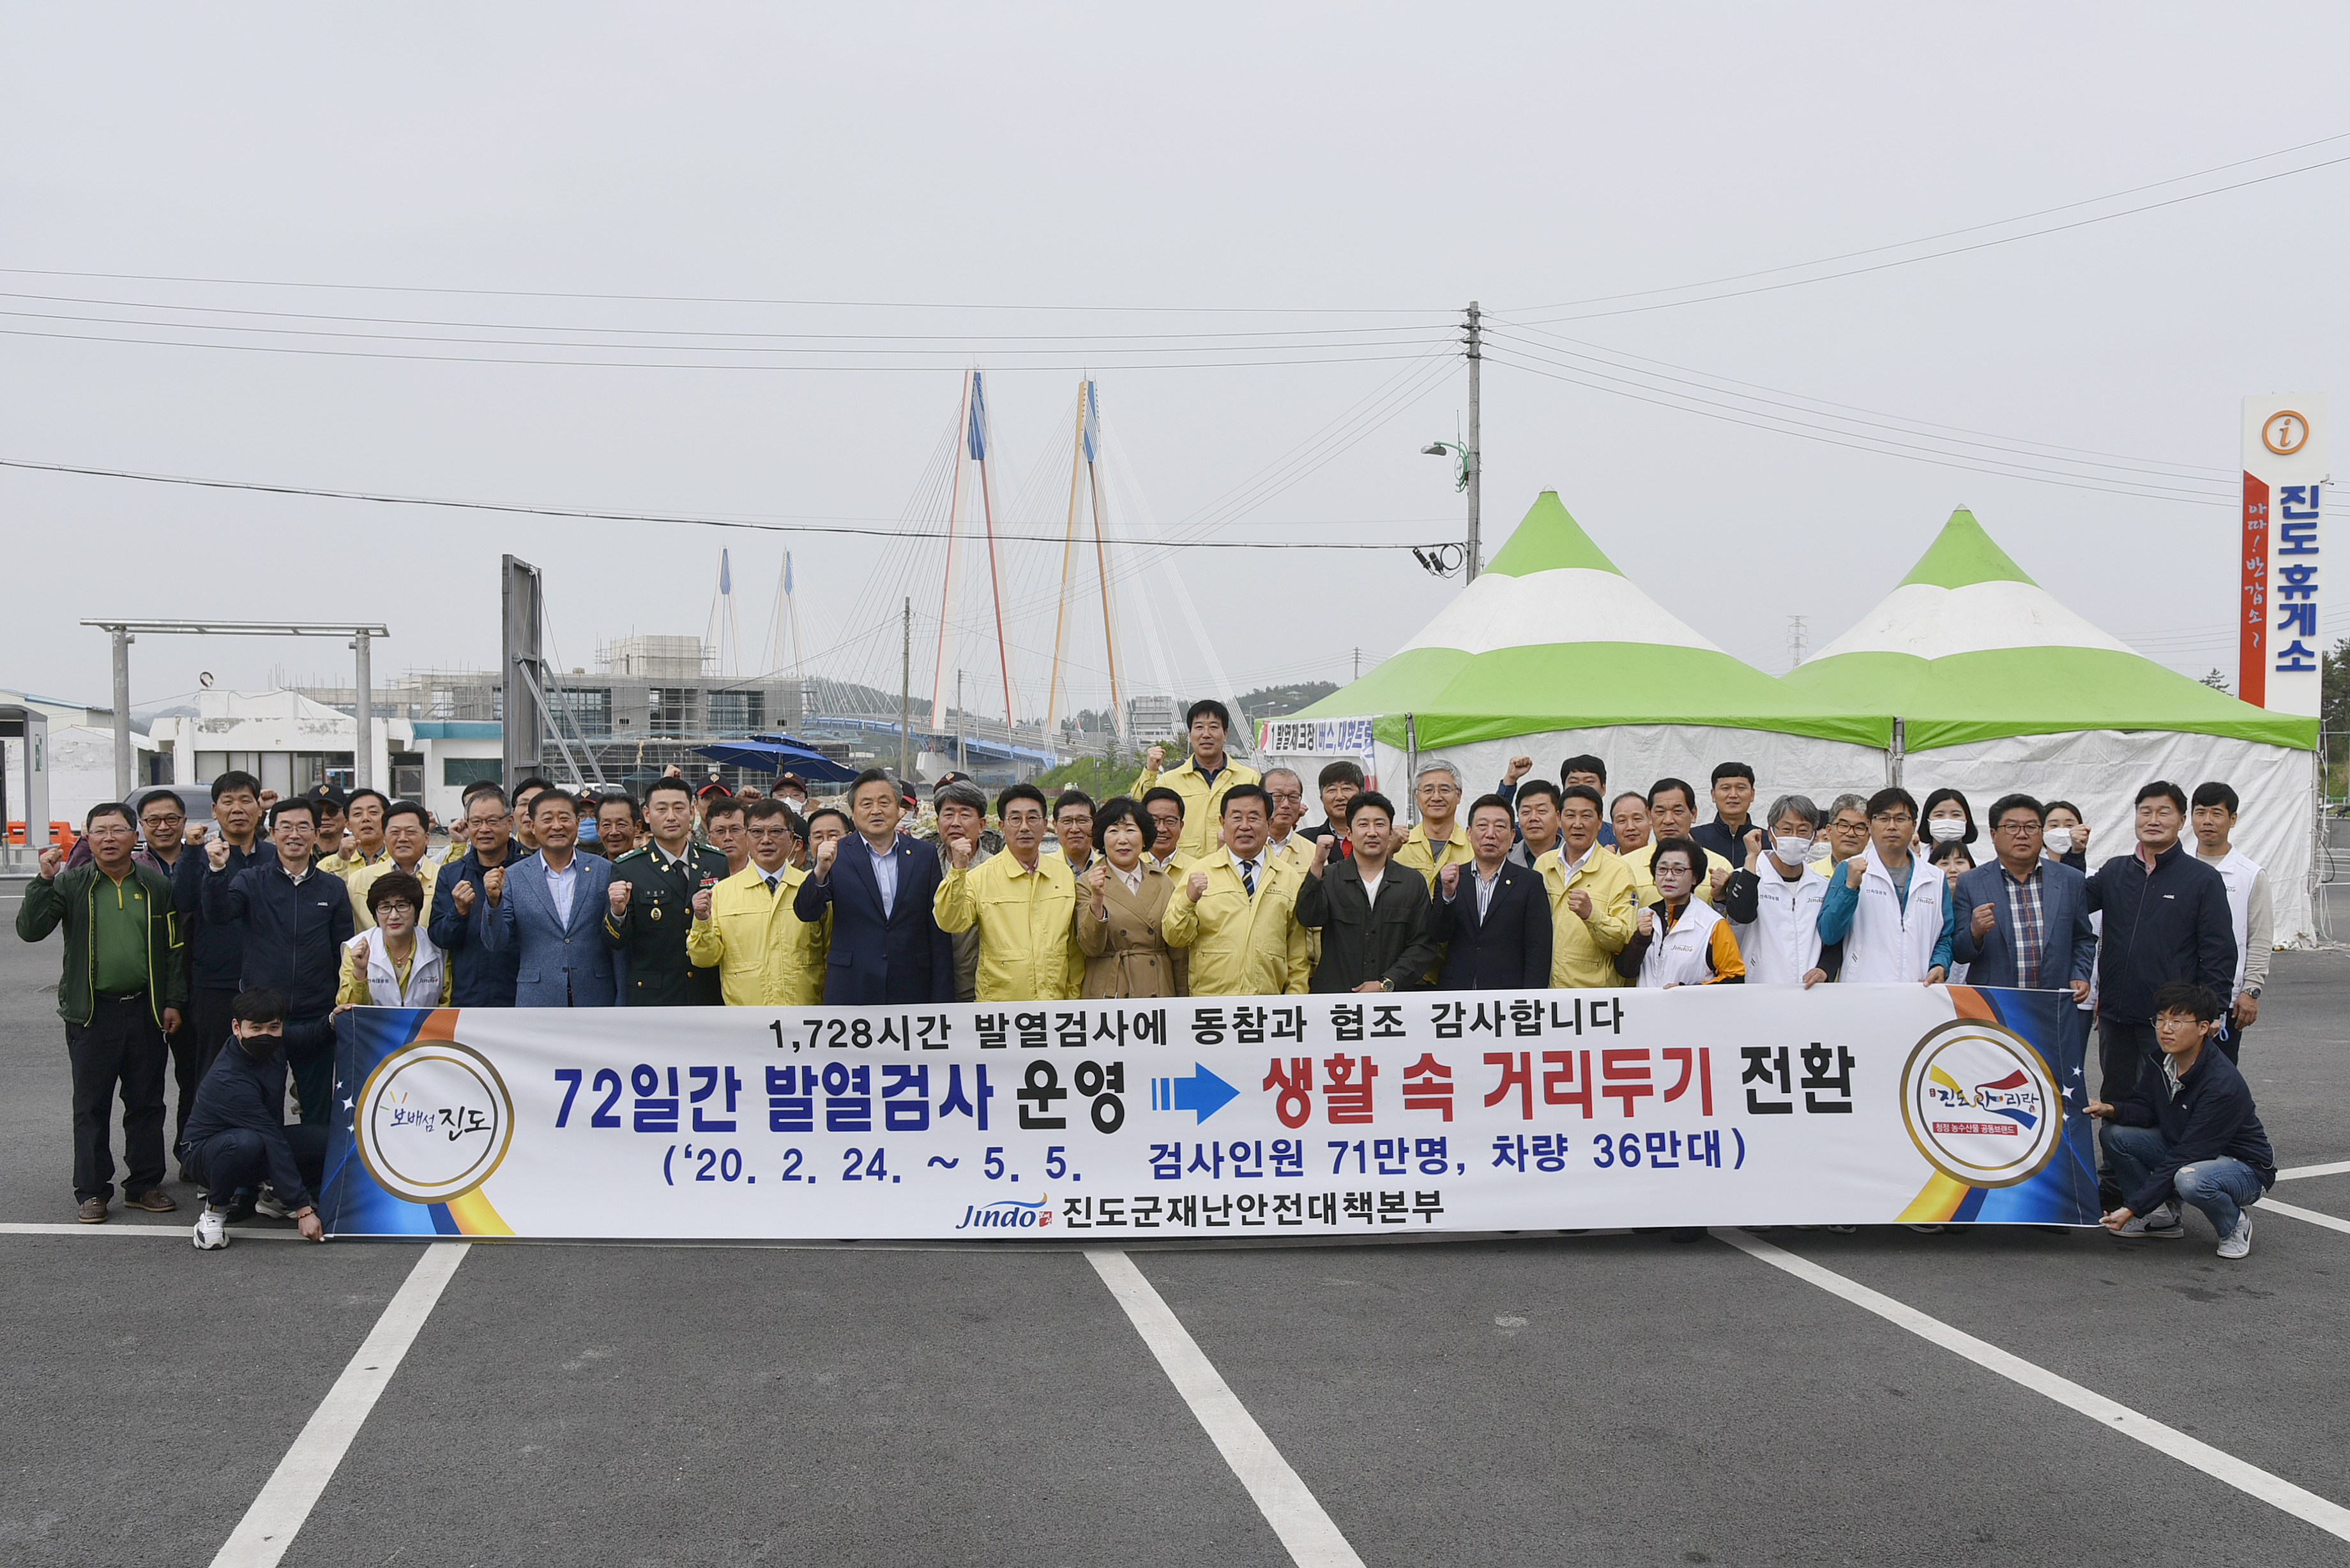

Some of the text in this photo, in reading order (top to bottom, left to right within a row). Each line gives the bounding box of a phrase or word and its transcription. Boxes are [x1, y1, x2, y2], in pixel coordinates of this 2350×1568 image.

[2276, 485, 2319, 672] 진도휴게소
[769, 998, 1623, 1053] 1,728시간 발열검사에 동참과 협조 감사합니다
[555, 1043, 1855, 1134] 72일간 발열검사 운영 생활 속 거리두기 전환
[390, 1106, 492, 1141] 보배섬 진도
[1936, 1123, 2015, 1134] 청정 농수산물 공동브랜드
[782, 1149, 815, 1183] 2.
[843, 1148, 900, 1182] 24.
[985, 1147, 1018, 1182] 5.
[1046, 1147, 1080, 1181] 5.
[1149, 1140, 1303, 1179] 검사인원
[1328, 1136, 1464, 1175] 71만명,
[1492, 1134, 1568, 1172] 차량
[1593, 1128, 1745, 1169] 36만대)
[955, 1205, 1036, 1229] Jindo
[1063, 1191, 1444, 1228] 진도군재난안전대책본부
